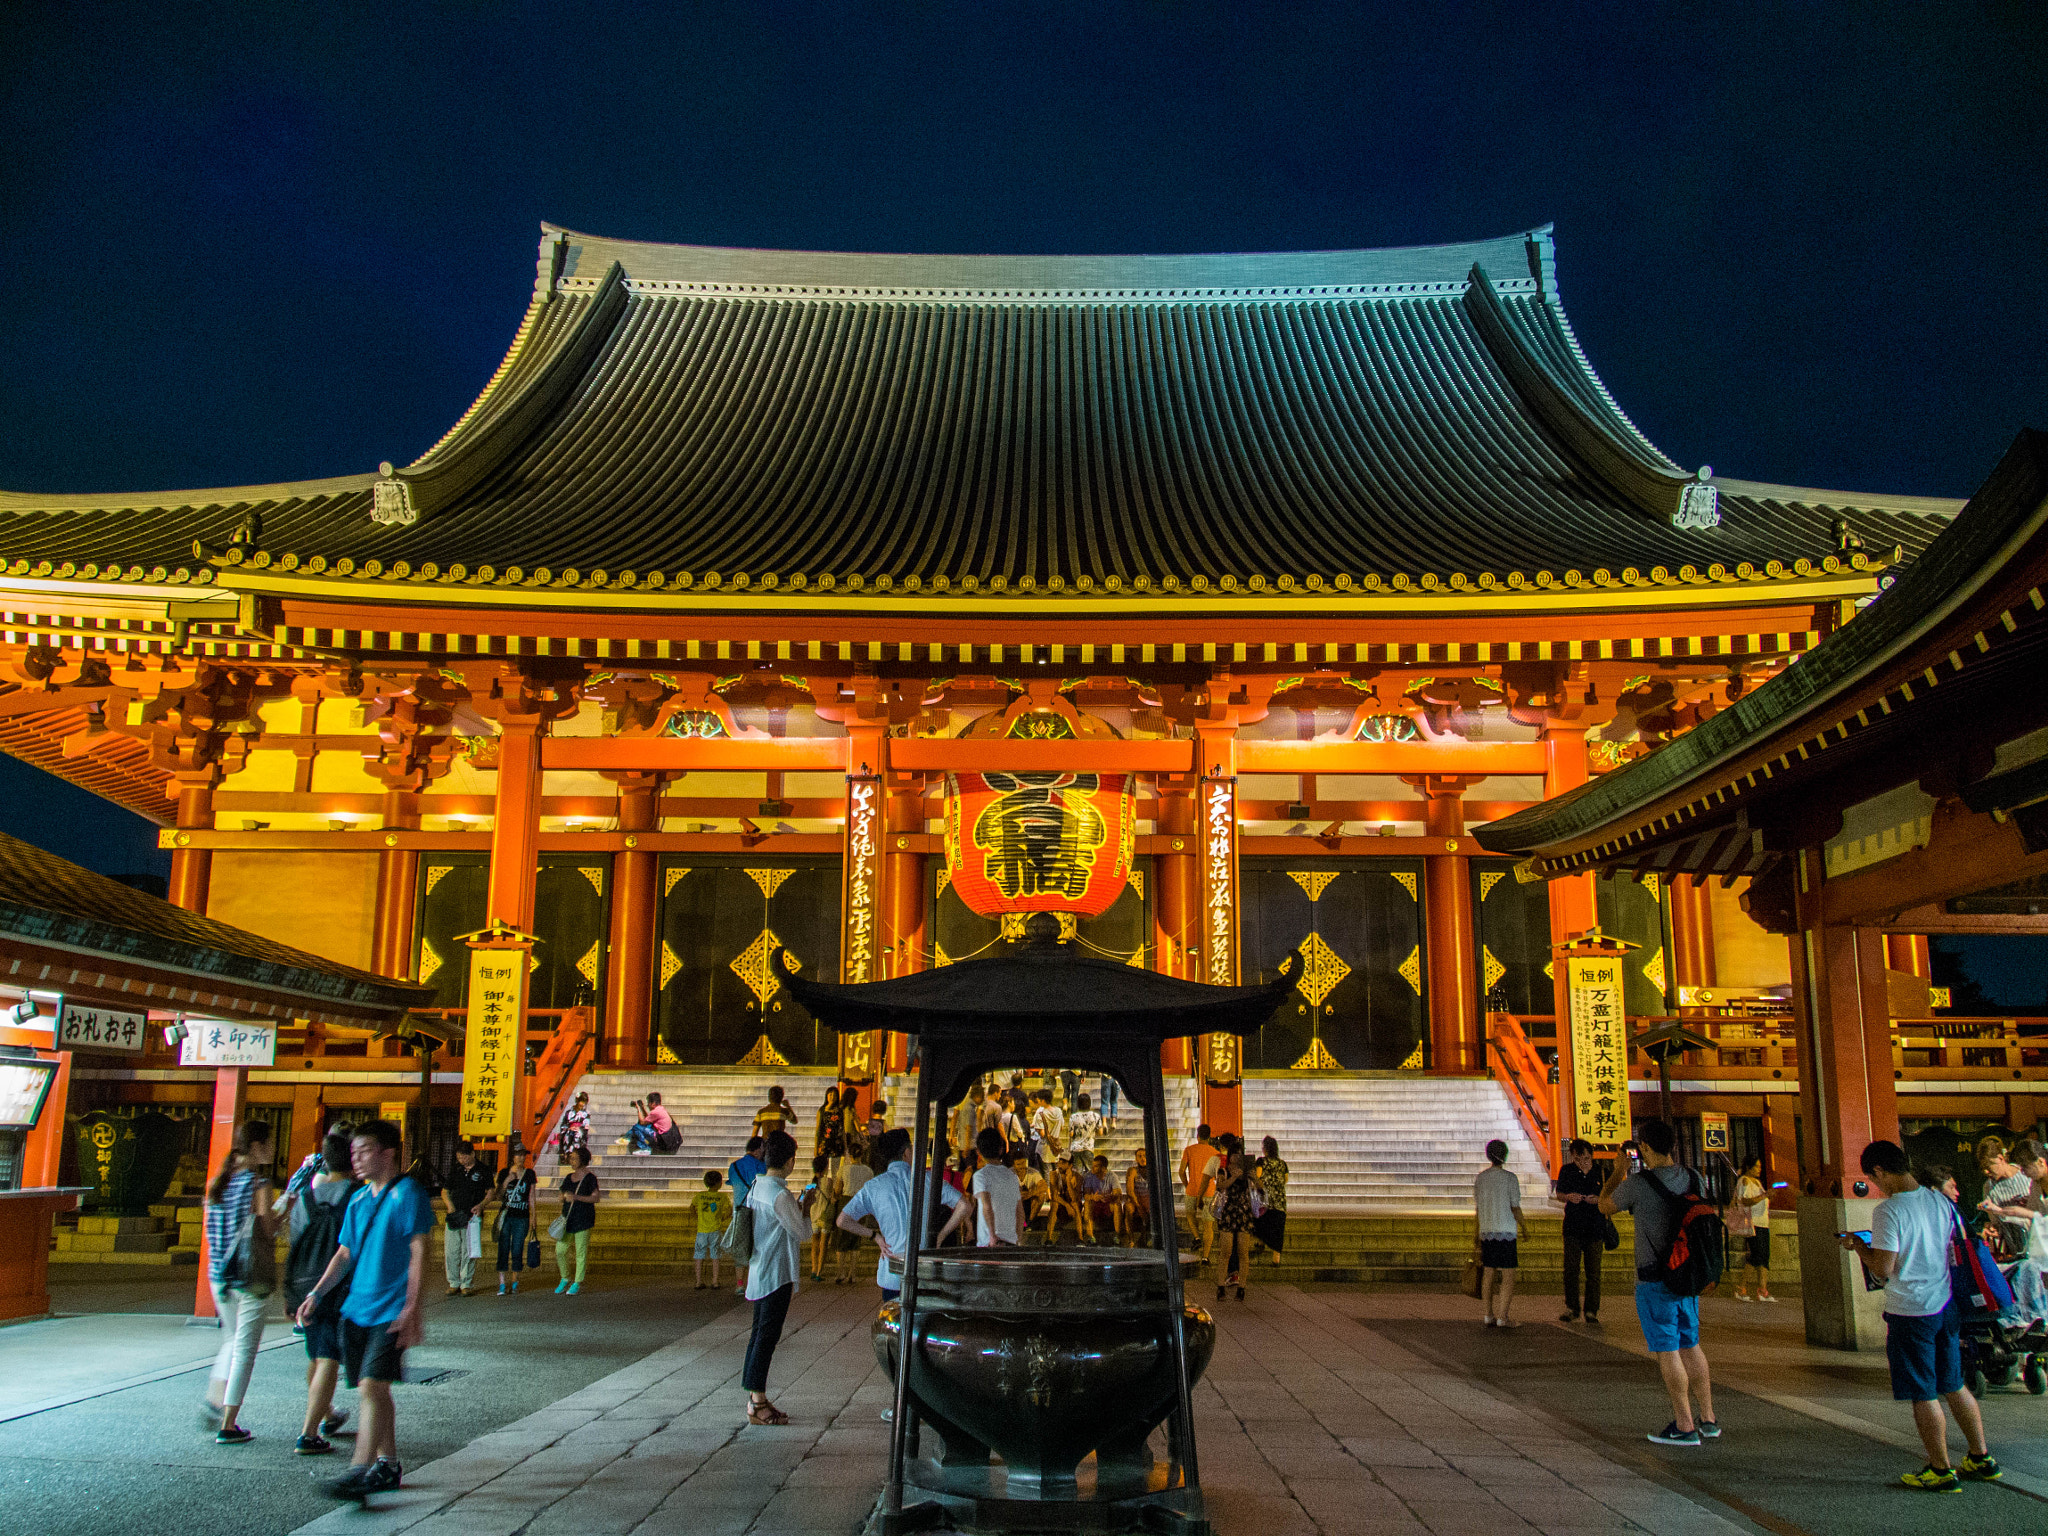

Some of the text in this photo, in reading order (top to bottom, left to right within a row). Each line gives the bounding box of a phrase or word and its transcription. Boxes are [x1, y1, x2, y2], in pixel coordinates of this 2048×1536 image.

[478, 966, 512, 980] 恒例
[1579, 968, 1613, 982] 恒例
[65, 1009, 137, 1046] お札お守
[208, 1027, 271, 1050] 朱印所
[502, 994, 515, 1080] 毎月十八日
